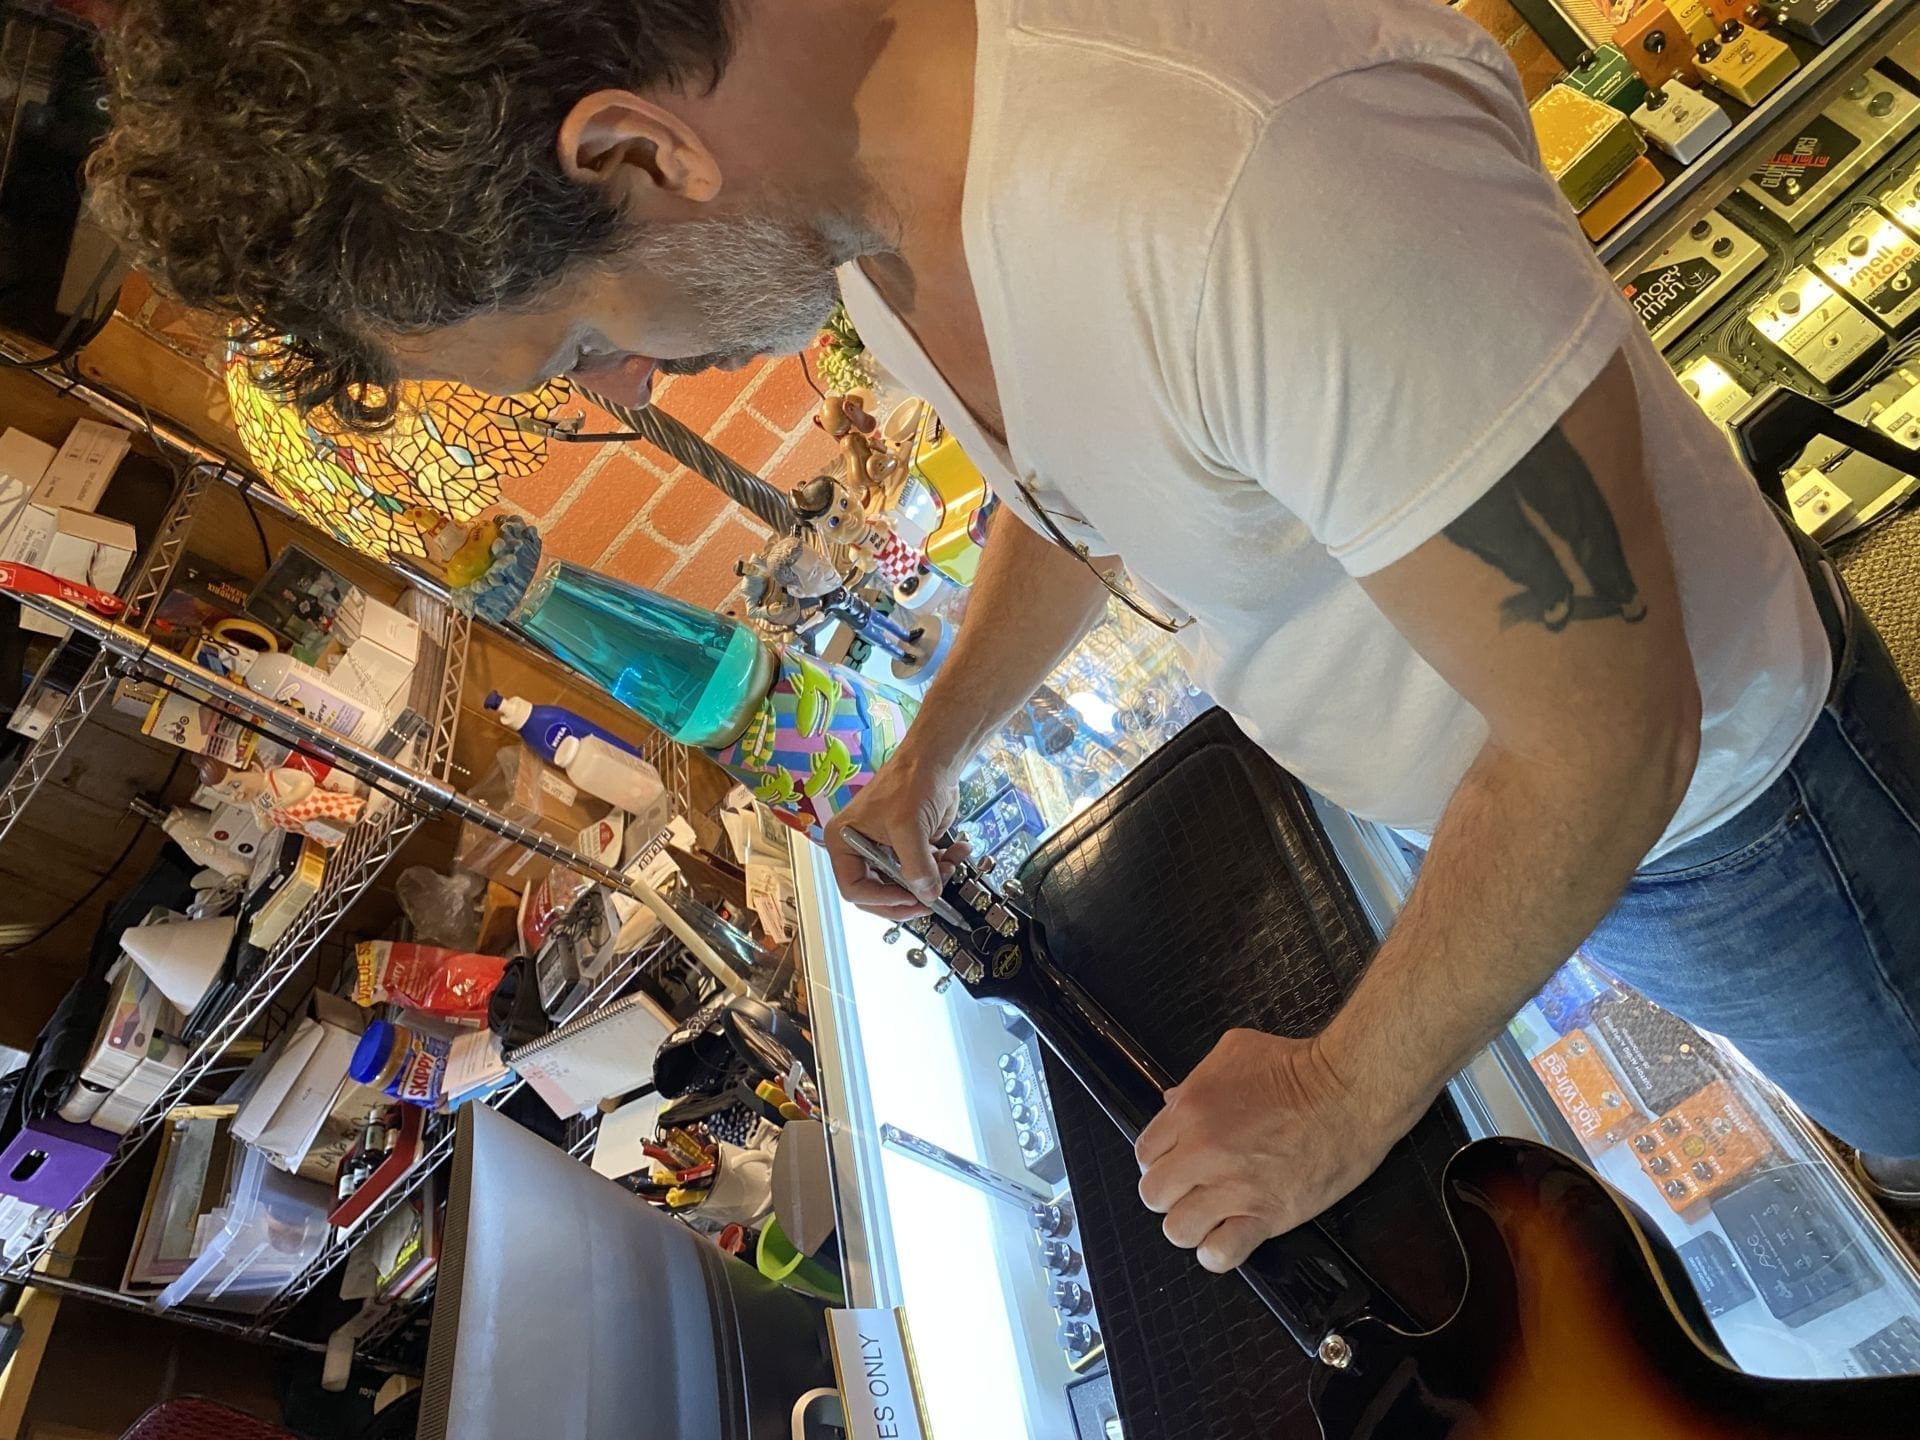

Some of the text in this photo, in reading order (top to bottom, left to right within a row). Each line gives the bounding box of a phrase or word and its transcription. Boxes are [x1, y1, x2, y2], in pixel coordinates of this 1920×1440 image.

[1849, 244, 1894, 286] small
[1869, 246, 1916, 287] stone
[1634, 265, 1680, 314] MORY
[551, 727, 567, 748] NIVEA
[358, 967, 373, 1004] VALUE
[408, 1053, 435, 1097] SKIPPY
[1542, 1055, 1602, 1138] Hot Wired
[858, 1332, 898, 1439] ES ONLY
